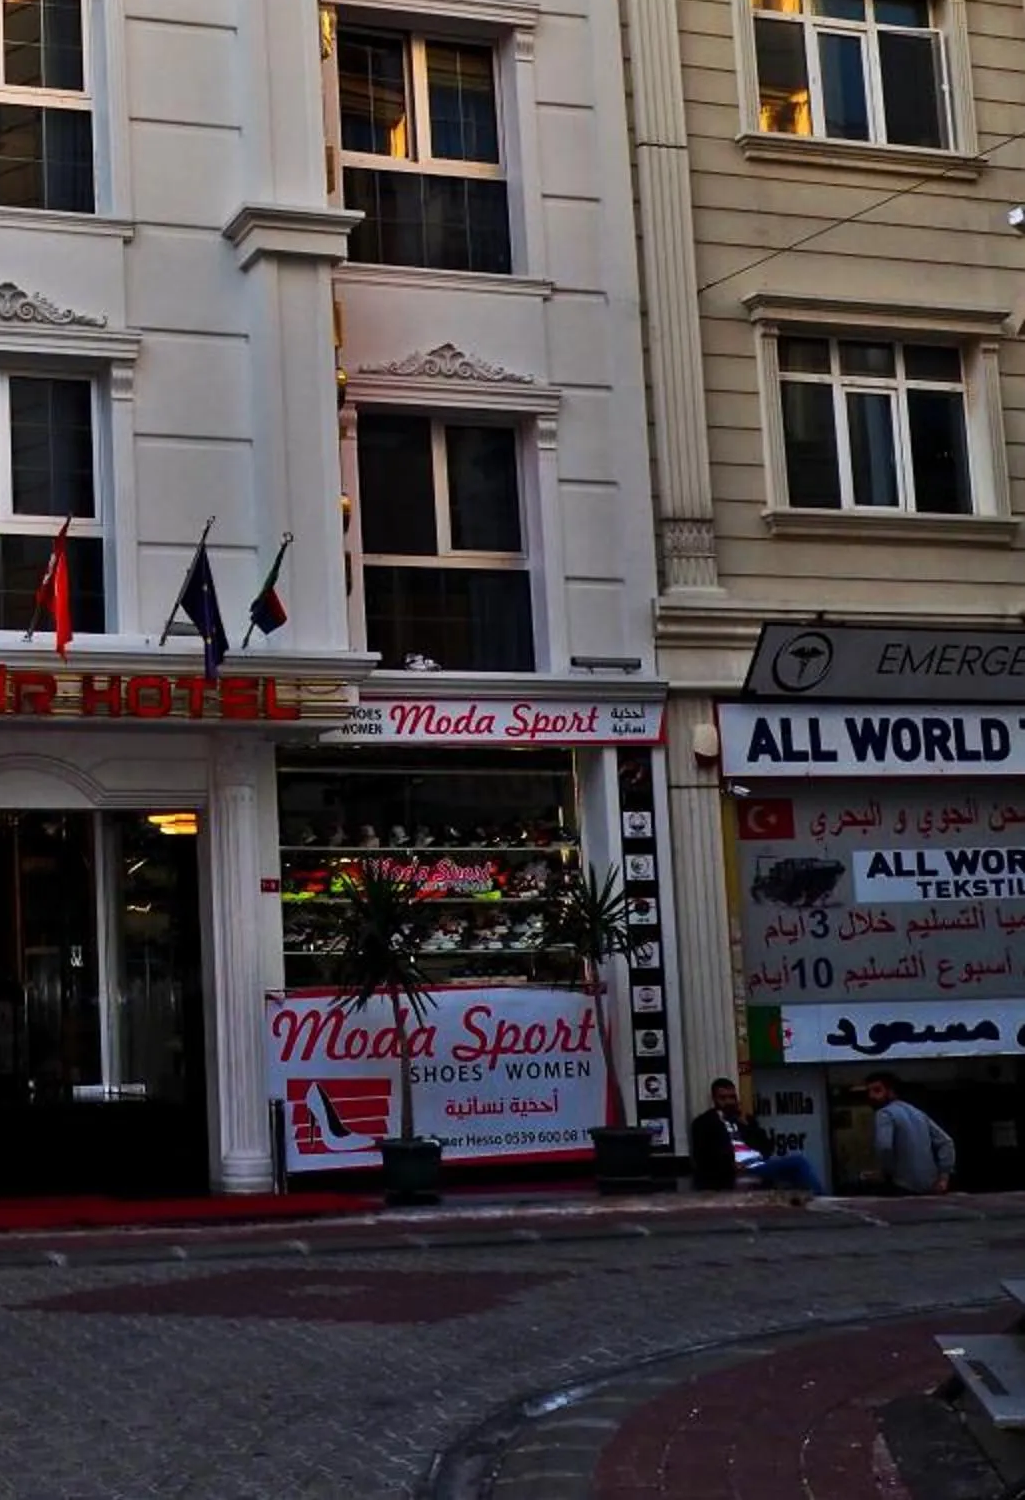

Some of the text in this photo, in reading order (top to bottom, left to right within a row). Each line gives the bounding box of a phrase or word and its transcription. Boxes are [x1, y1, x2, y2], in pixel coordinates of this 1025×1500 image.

[81, 673, 302, 722] HOTEL
[346, 706, 382, 721] HOES
[389, 703, 600, 739] Moda Sport
[747, 717, 1011, 762] ALL WORLD
[867, 851, 938, 879] ALL
[917, 879, 1025, 899] TEKSTIL
[272, 1005, 596, 1071] Moda Sport
[827, 1017, 1000, 1055] مسعود
[409, 1060, 592, 1084] SHOES WOMEN
